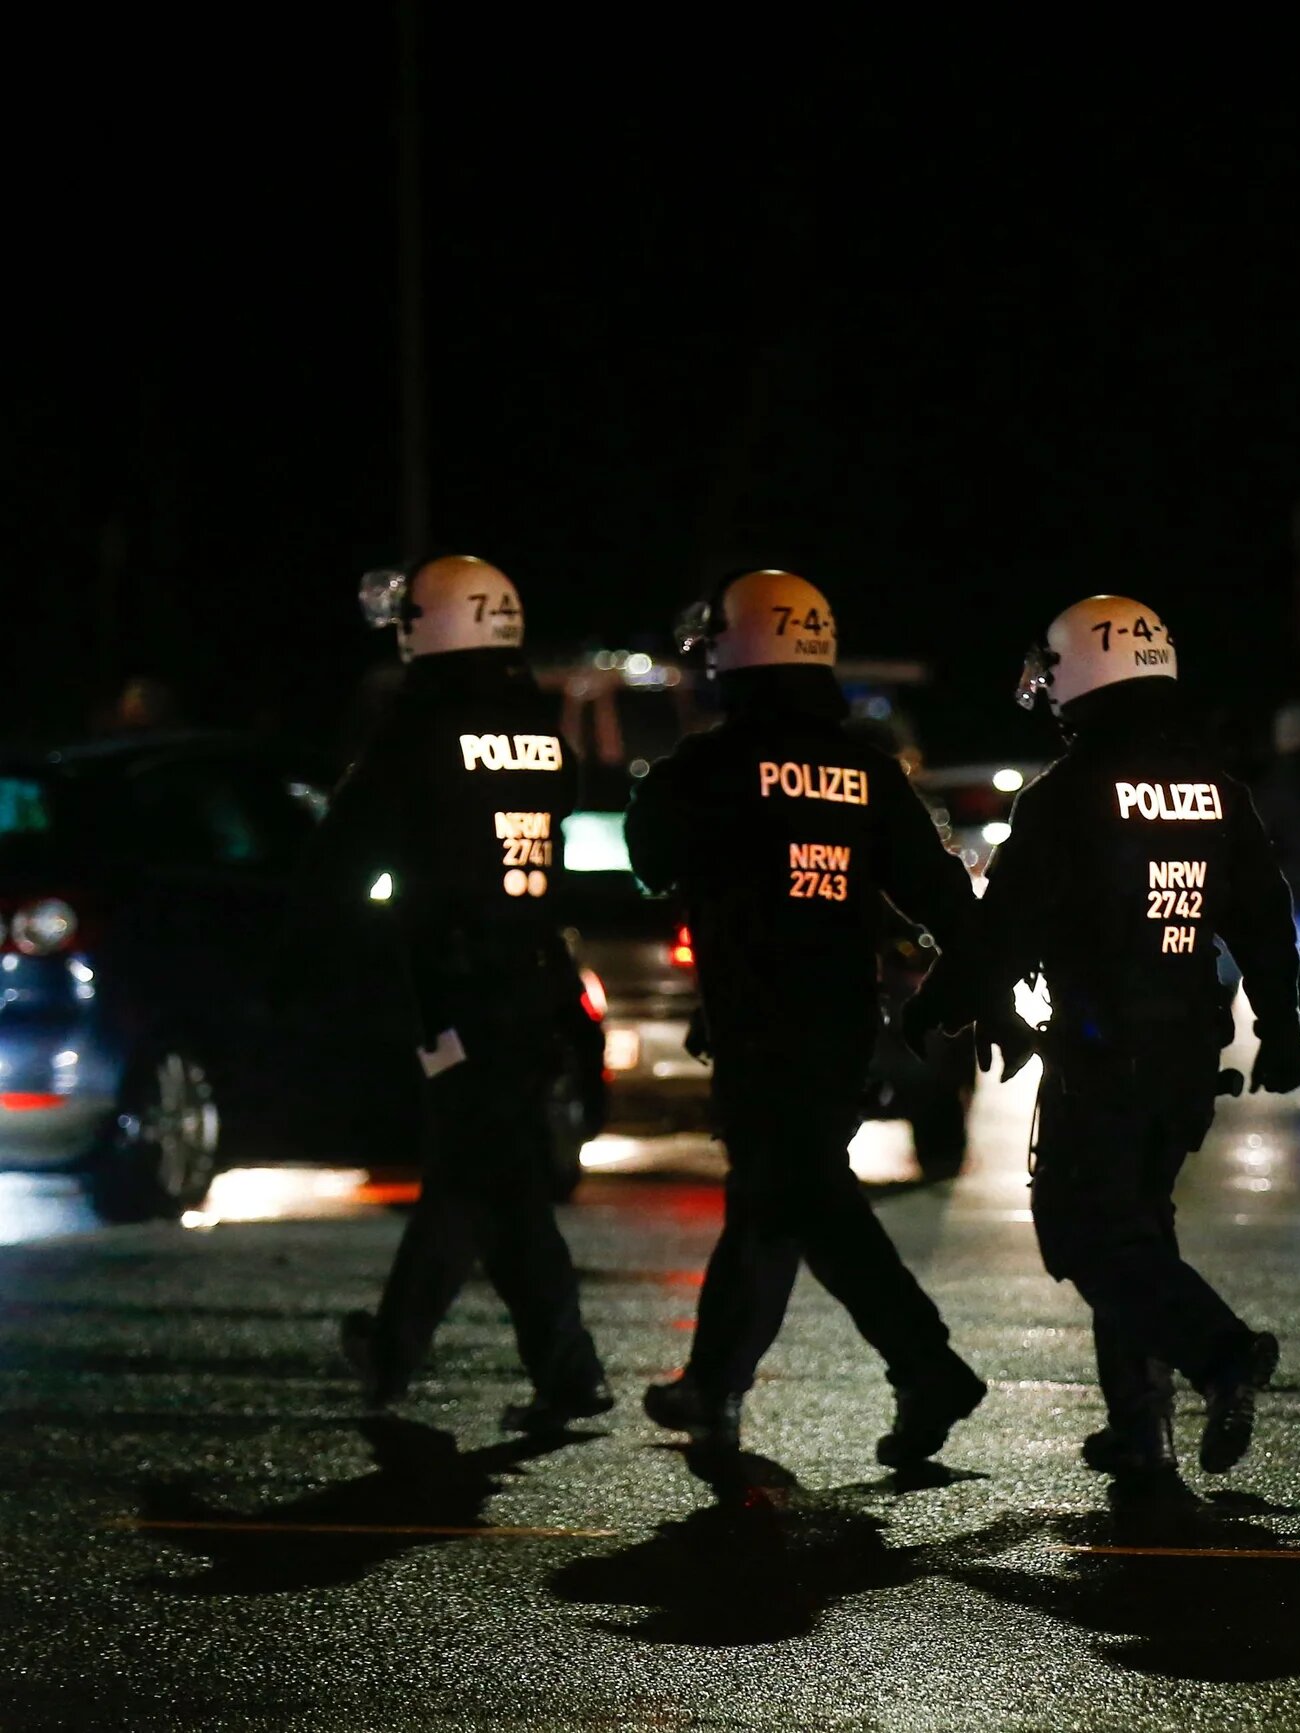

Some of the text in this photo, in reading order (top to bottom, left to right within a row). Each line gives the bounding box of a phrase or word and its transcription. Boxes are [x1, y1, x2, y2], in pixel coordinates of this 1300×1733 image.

[459, 734, 563, 771] POLIZEI
[759, 761, 869, 806] POLIZEI
[1115, 782, 1223, 820] POLIZEI
[503, 838, 552, 866] 2741
[789, 843, 850, 871] NRW
[789, 870, 848, 901] 2743
[1149, 861, 1207, 889] NRW
[1147, 890, 1203, 918] 2742
[1162, 926, 1196, 953] RH
